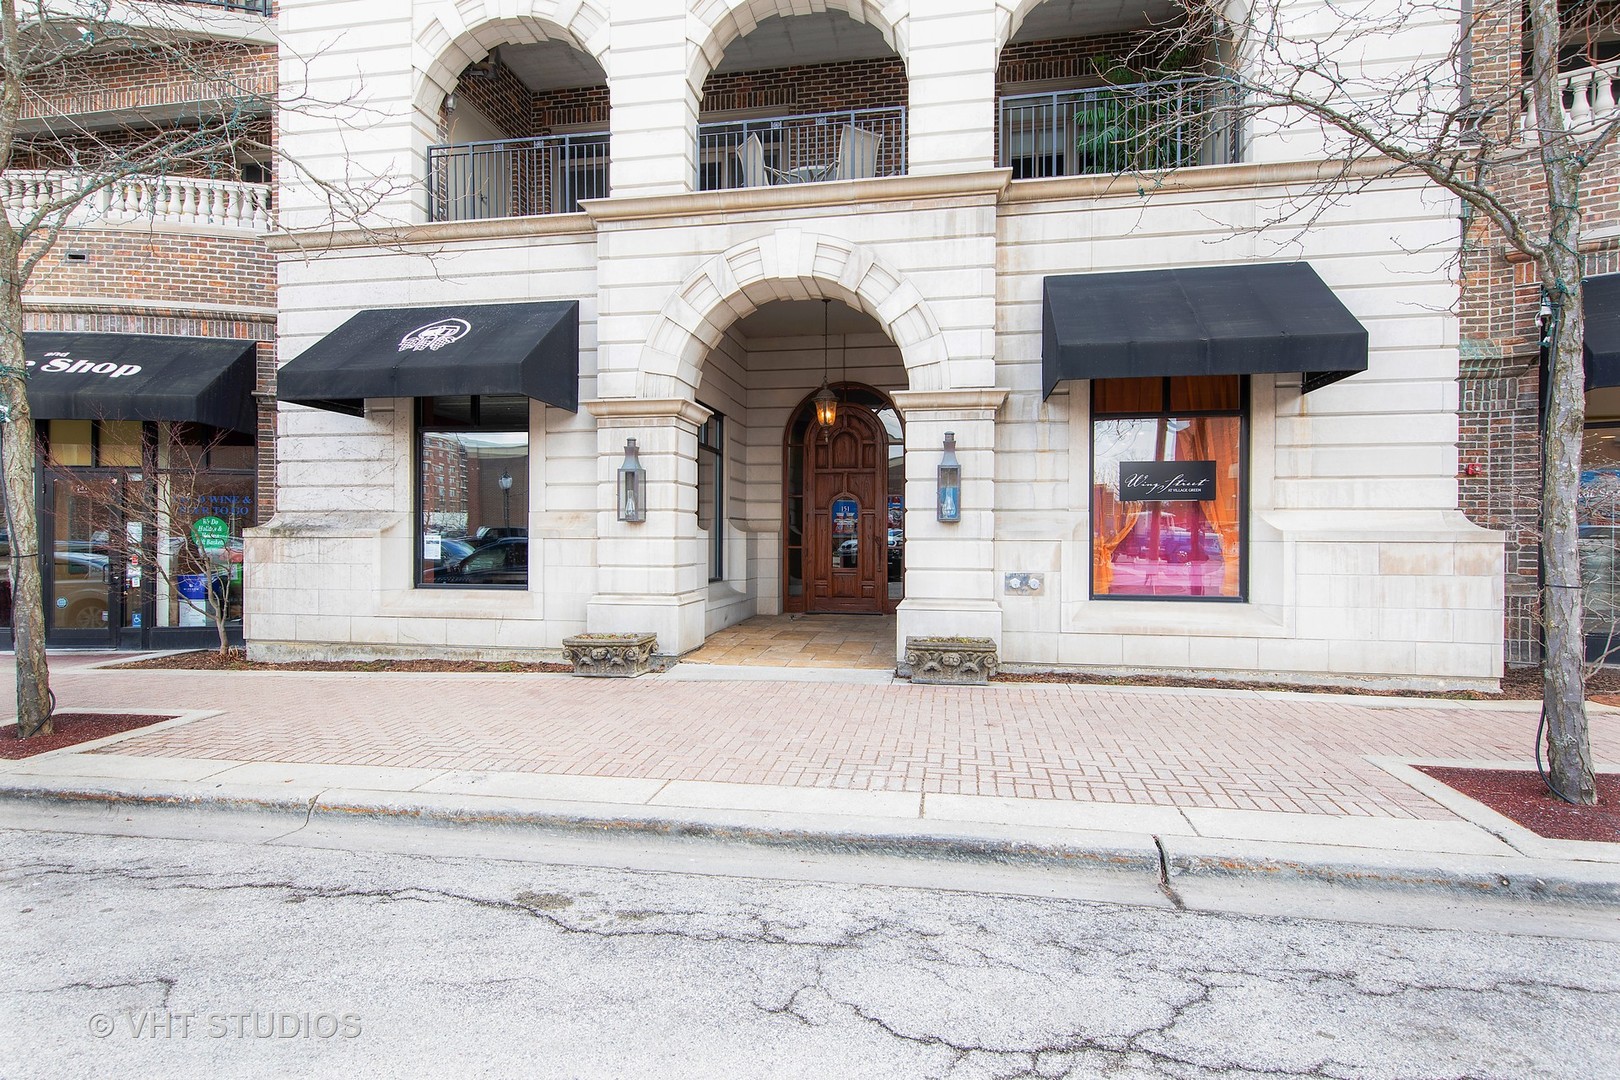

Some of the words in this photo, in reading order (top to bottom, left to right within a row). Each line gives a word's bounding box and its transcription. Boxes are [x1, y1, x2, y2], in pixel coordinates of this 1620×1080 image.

[40, 358, 142, 378] Shop
[1125, 473, 1160, 495] Wing
[1157, 473, 1210, 494] Street
[208, 495, 240, 504] WINE
[242, 495, 251, 504] &
[212, 506, 229, 514] TO
[231, 506, 249, 515] GO
